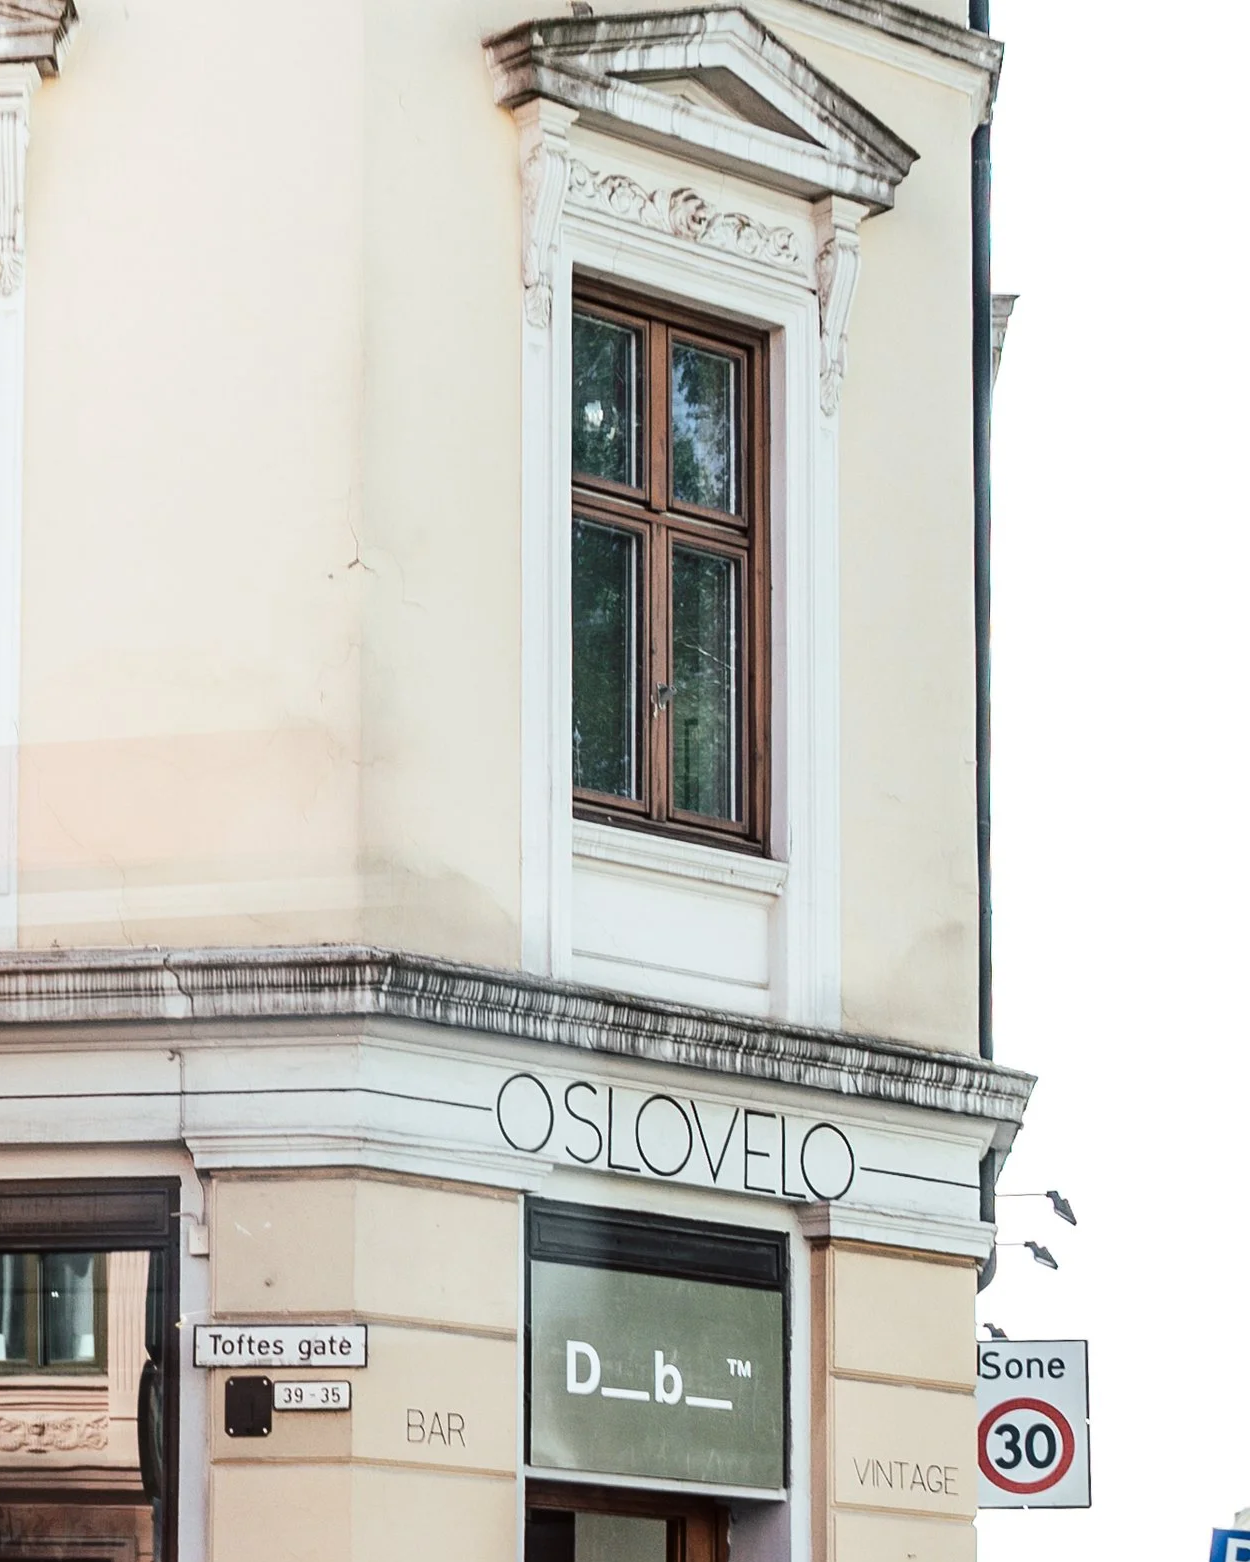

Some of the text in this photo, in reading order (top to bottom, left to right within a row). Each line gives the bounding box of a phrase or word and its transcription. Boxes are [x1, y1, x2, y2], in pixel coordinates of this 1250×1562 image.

[496, 1072, 856, 1201] OSLOVELO
[209, 1334, 352, 1360] Toftes gate
[981, 1351, 1066, 1380] Sone
[406, 1408, 466, 1448] BAR
[994, 1423, 1057, 1470] 30
[852, 1457, 959, 1496] VINTAGE
